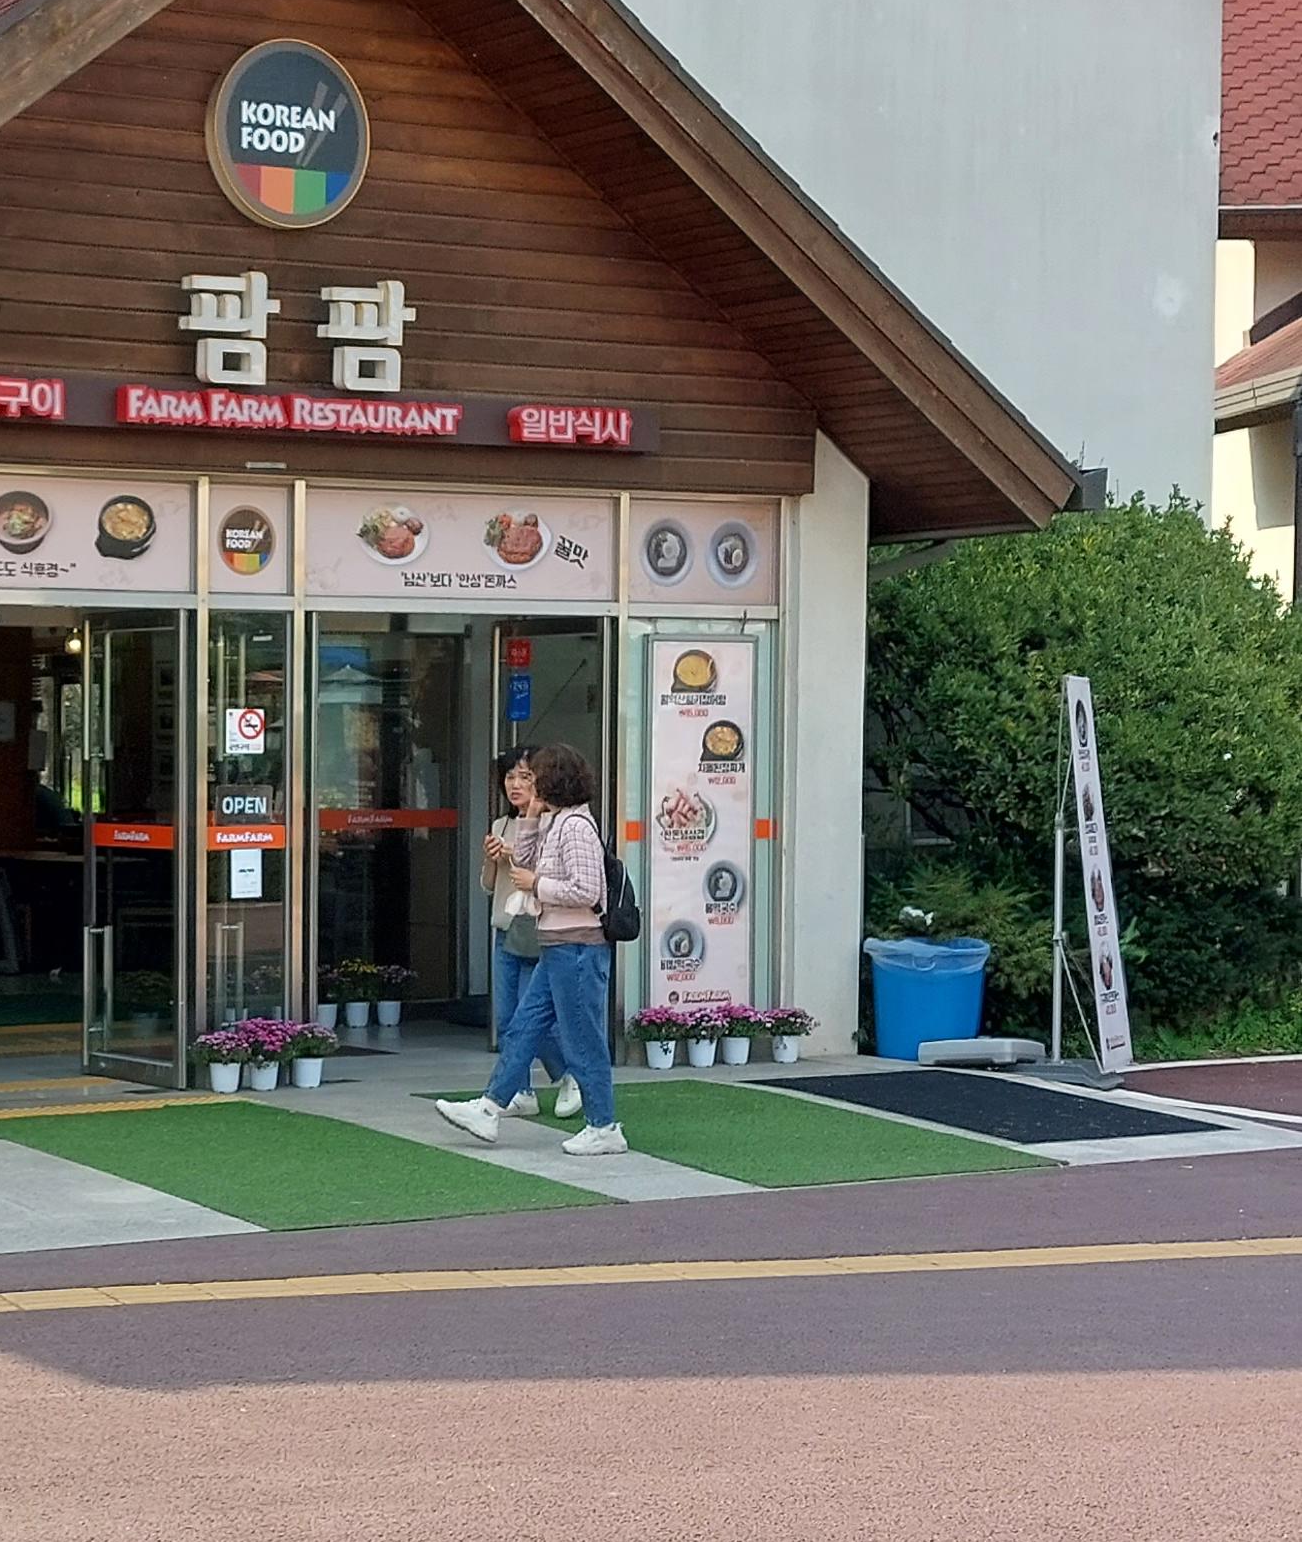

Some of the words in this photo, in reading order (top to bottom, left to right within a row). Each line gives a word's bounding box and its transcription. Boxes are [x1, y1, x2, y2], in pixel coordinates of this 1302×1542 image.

[241, 100, 336, 133] KOREAN
[241, 126, 306, 153] FOOD
[127, 387, 204, 421] FARM
[210, 391, 286, 427] FARM
[295, 397, 460, 435] RESTAURANT
[520, 407, 630, 445] 일반식사
[226, 528, 264, 540] KOREAN
[226, 539, 251, 549] FOOD
[222, 796, 267, 815] OPEN
